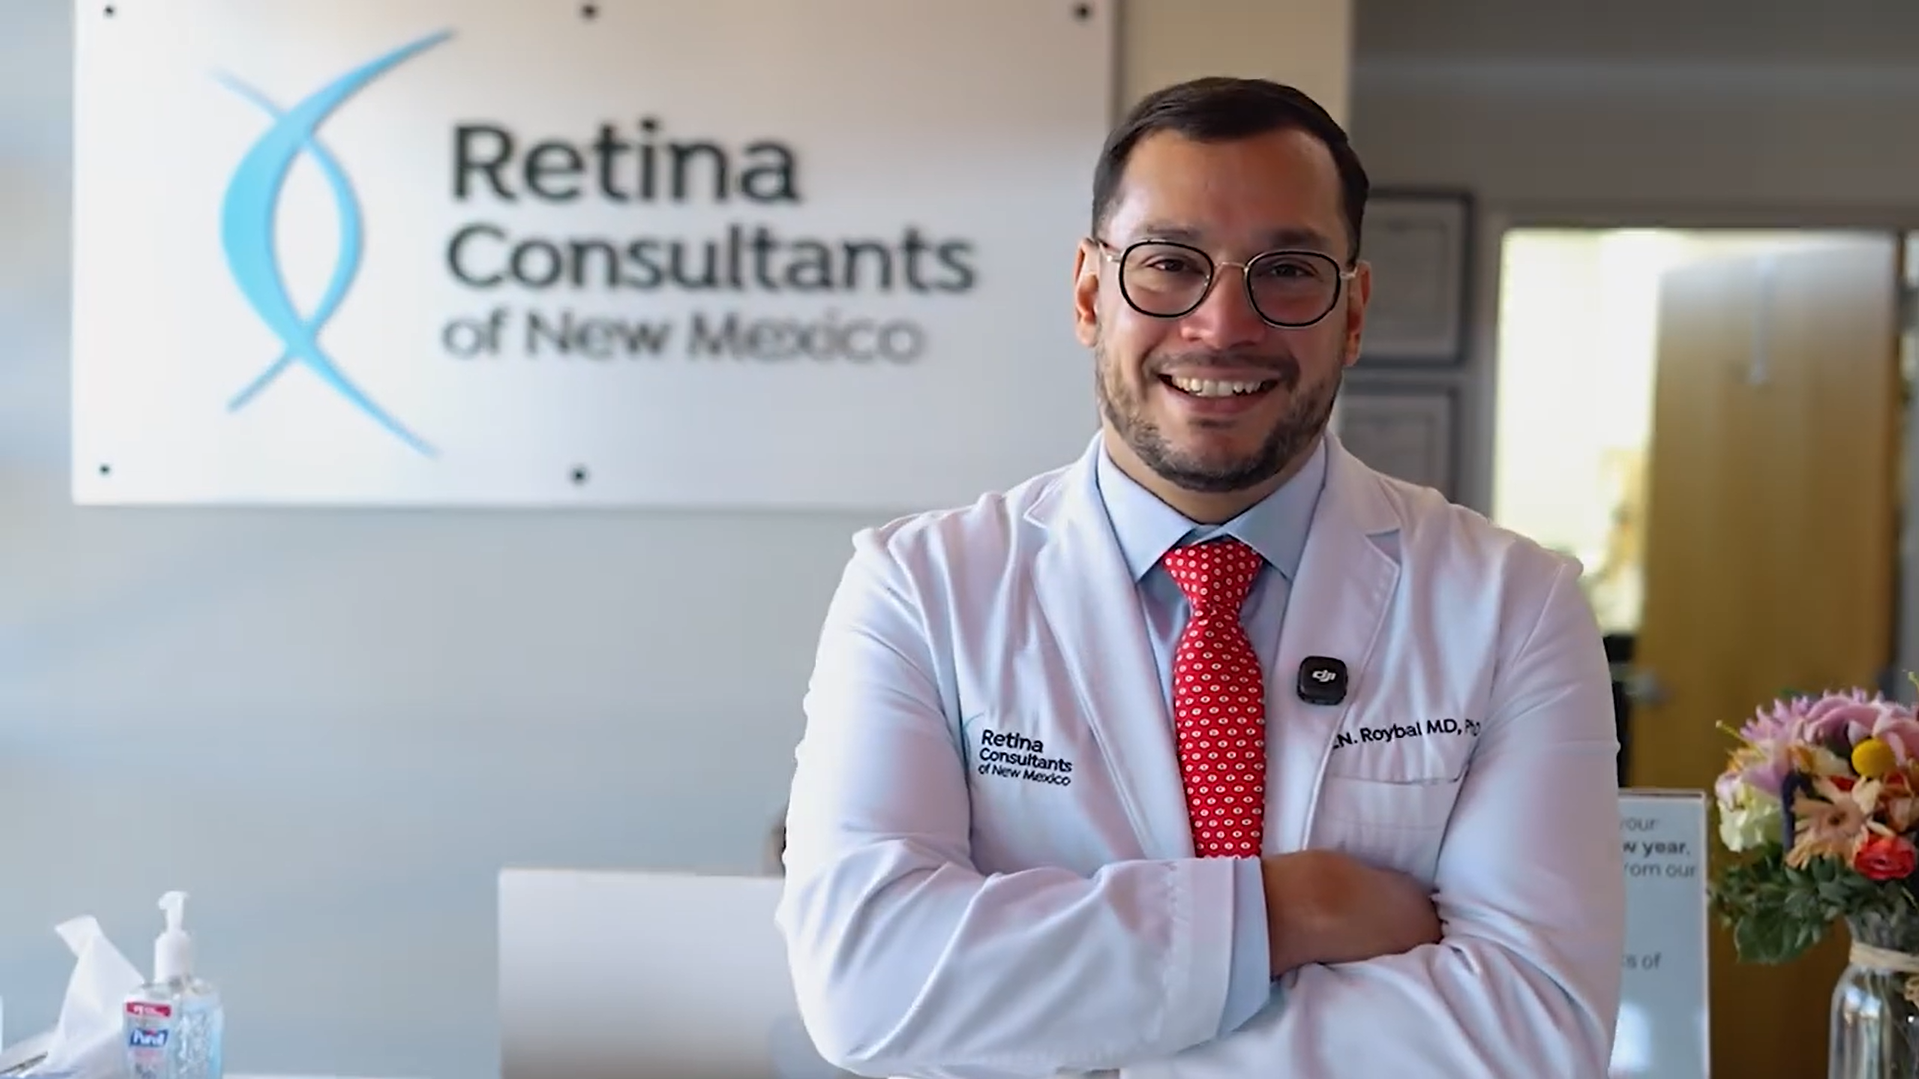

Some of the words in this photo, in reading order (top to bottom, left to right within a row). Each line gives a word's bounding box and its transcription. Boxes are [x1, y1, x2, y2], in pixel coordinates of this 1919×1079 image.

[452, 117, 803, 204] Retina
[446, 221, 976, 291] Consultants
[441, 305, 506, 360] of
[524, 309, 673, 358] New
[687, 307, 927, 365] Mexico
[981, 729, 1044, 754] Retina
[1360, 721, 1423, 743] Roybal
[1426, 718, 1462, 736] MD,
[979, 747, 1073, 773] Consultants
[978, 762, 991, 775] of
[991, 764, 1021, 778] New
[1022, 769, 1072, 787] Mexico
[1665, 863, 1696, 879] our
[1641, 951, 1663, 971] of
